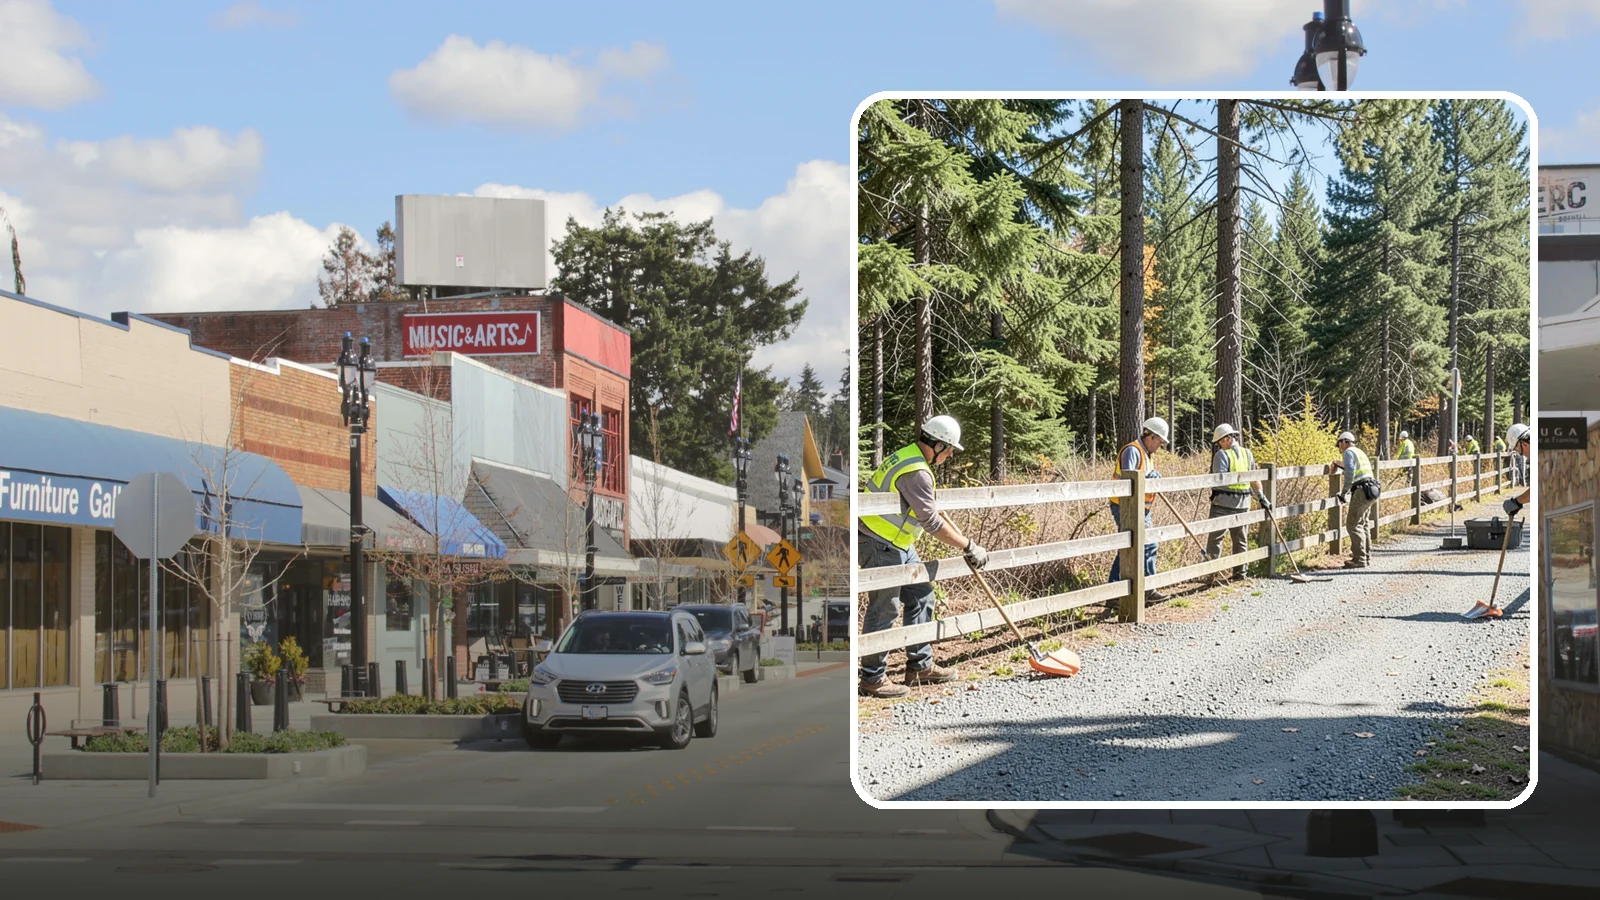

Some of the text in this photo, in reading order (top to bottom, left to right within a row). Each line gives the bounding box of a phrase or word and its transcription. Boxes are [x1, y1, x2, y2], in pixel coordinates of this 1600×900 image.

[409, 323, 519, 348] MUSIC&ARTS
[0, 471, 122, 519] Furniture Gal
